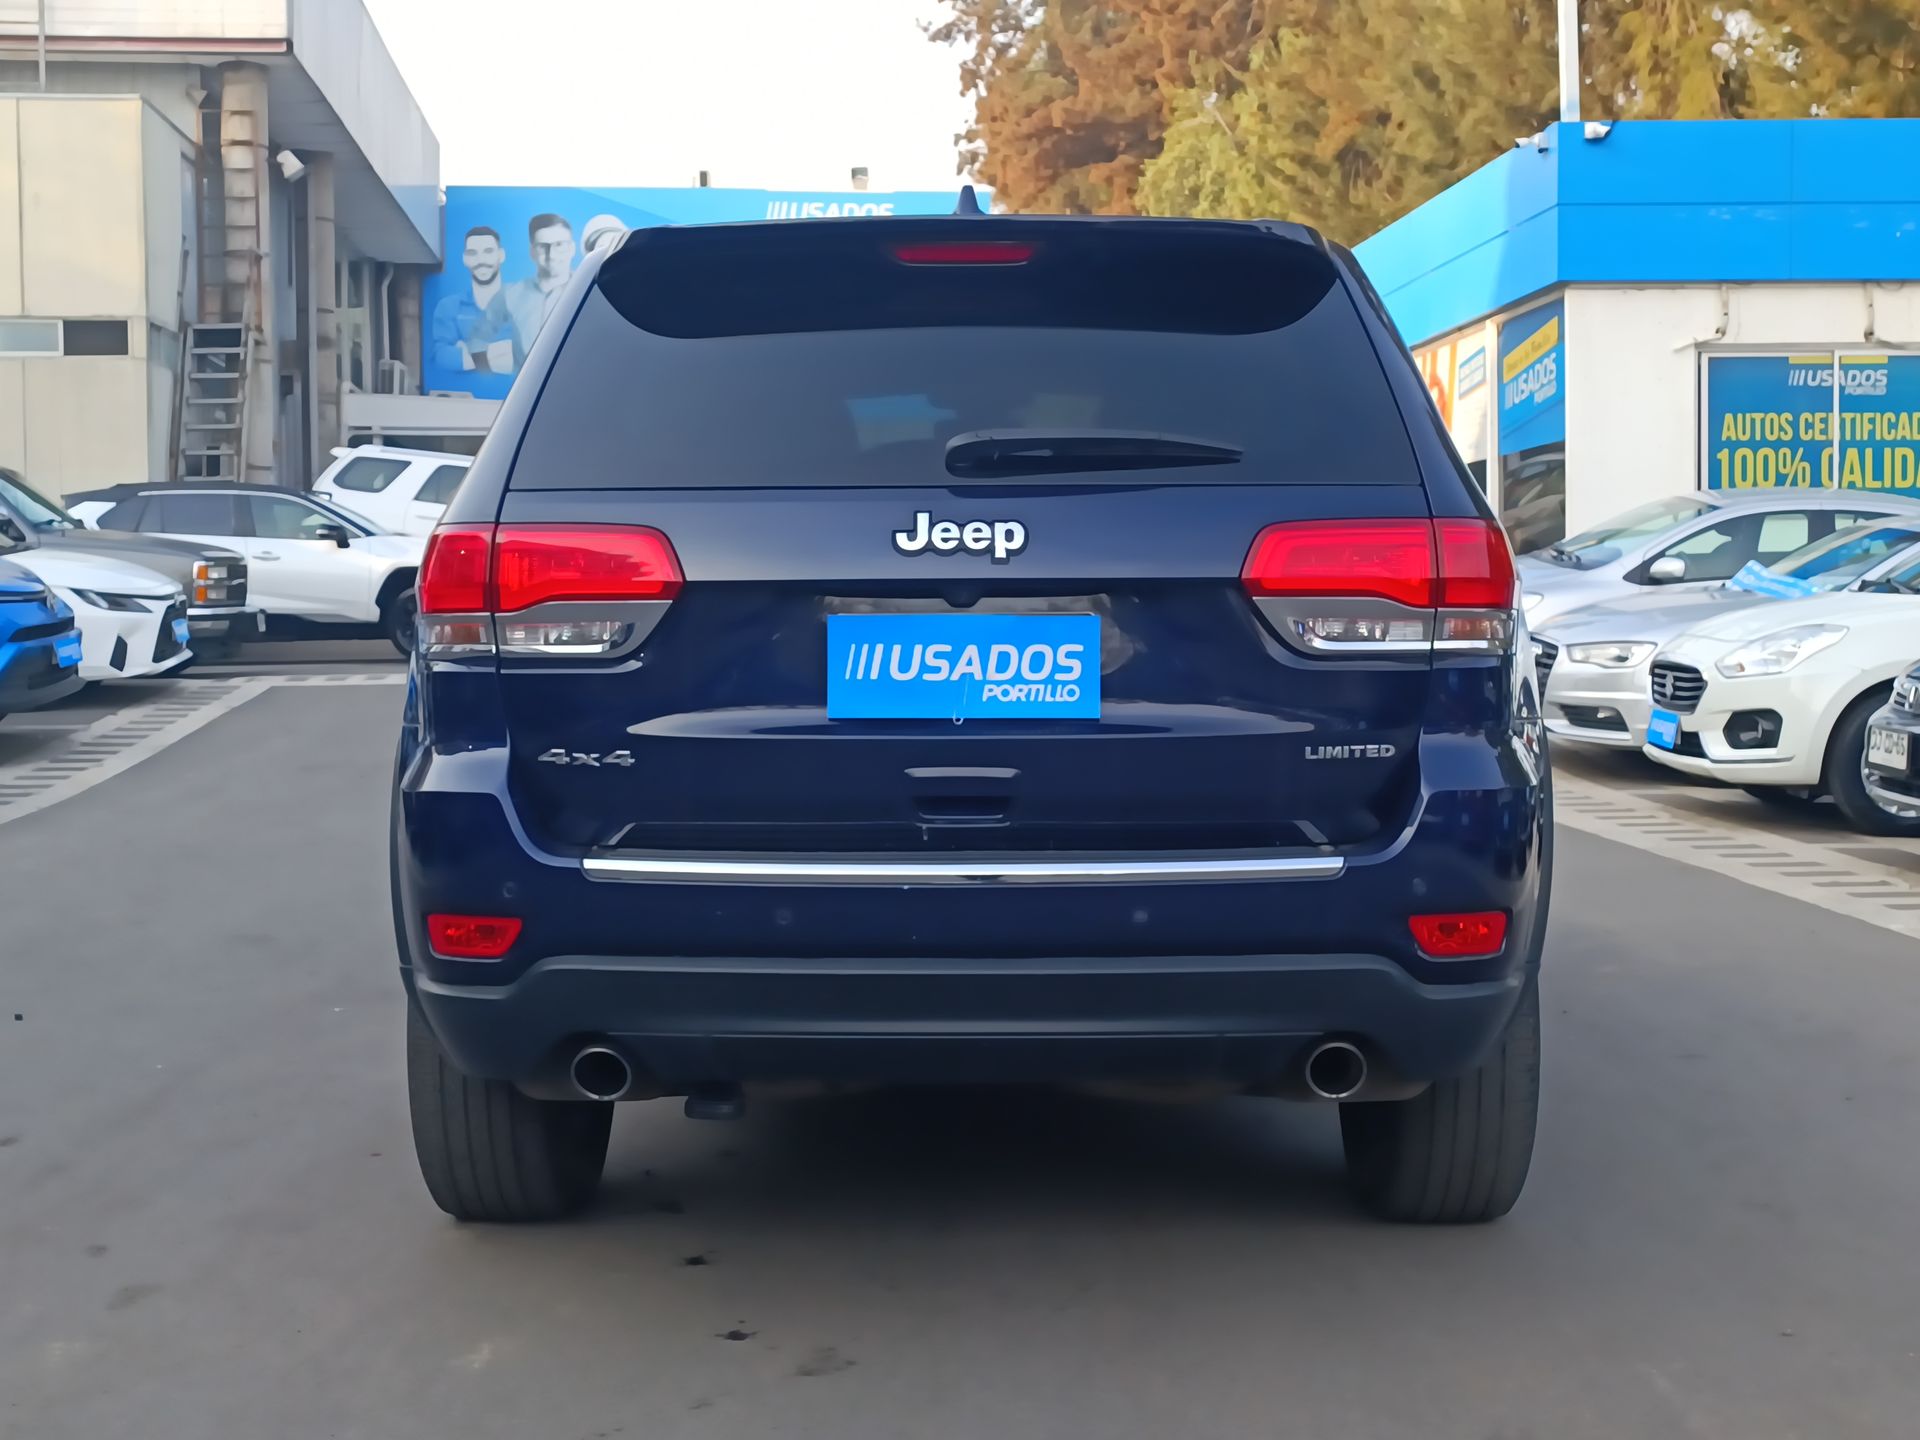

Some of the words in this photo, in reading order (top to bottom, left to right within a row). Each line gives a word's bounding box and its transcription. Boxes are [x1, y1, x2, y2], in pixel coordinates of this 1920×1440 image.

[1513, 352, 1557, 404] USADOS
[1721, 412, 1793, 441] AUTOS
[1717, 447, 1811, 489] 100%
[893, 511, 1027, 563] Jeep
[889, 644, 1084, 681] USADOS
[982, 684, 1080, 702] PORTILLO
[538, 749, 635, 767] 4x4
[1304, 744, 1396, 760] LIMITED
